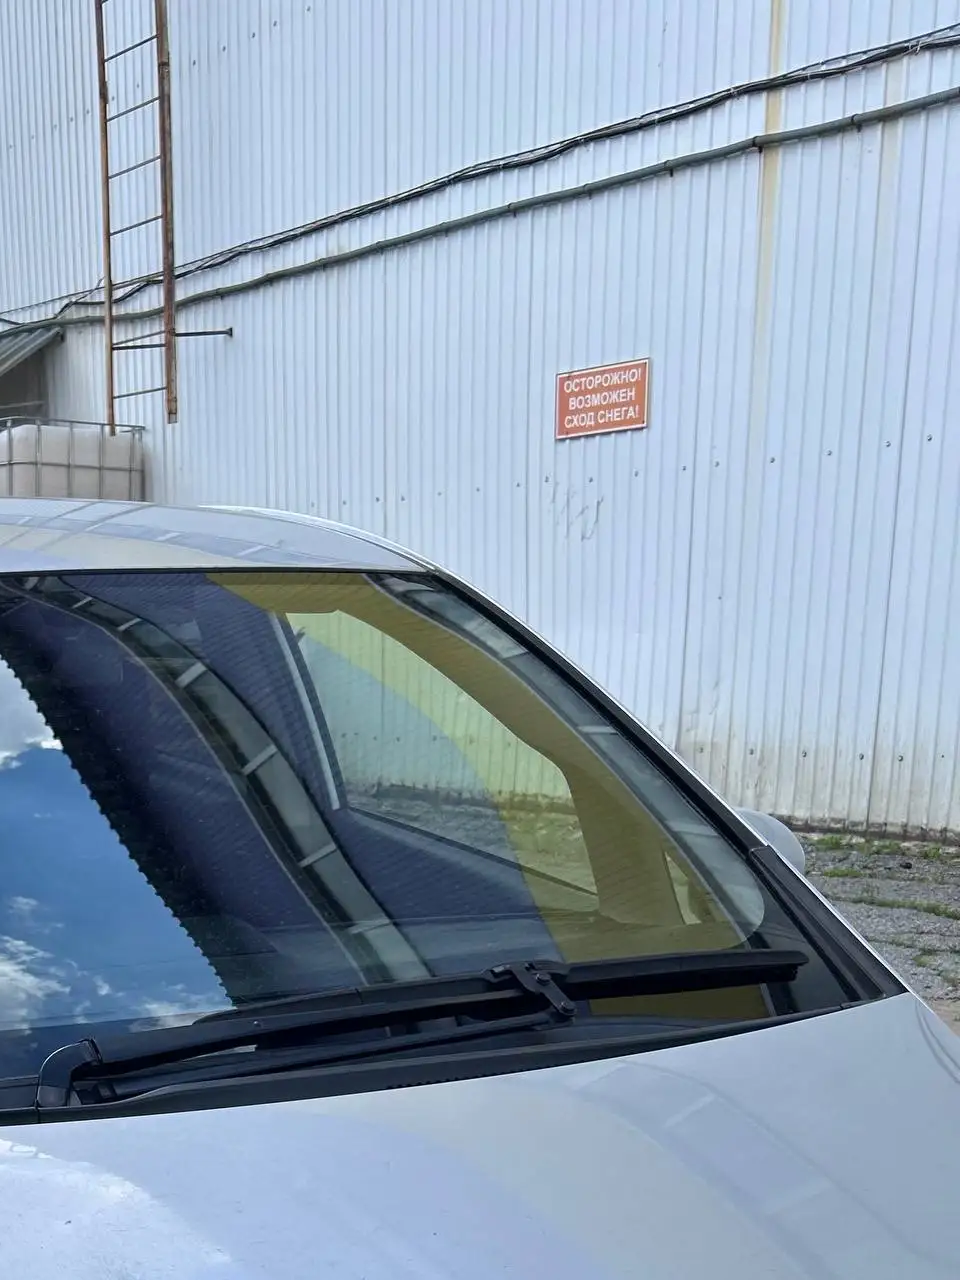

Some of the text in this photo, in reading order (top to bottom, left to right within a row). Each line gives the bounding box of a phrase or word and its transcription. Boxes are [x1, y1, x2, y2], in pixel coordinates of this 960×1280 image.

[563, 368, 642, 393] ОСТОРОЖНО!
[568, 387, 636, 411] ВОЗМОЖЕН
[564, 405, 640, 429] СХОД СНЕГА!
